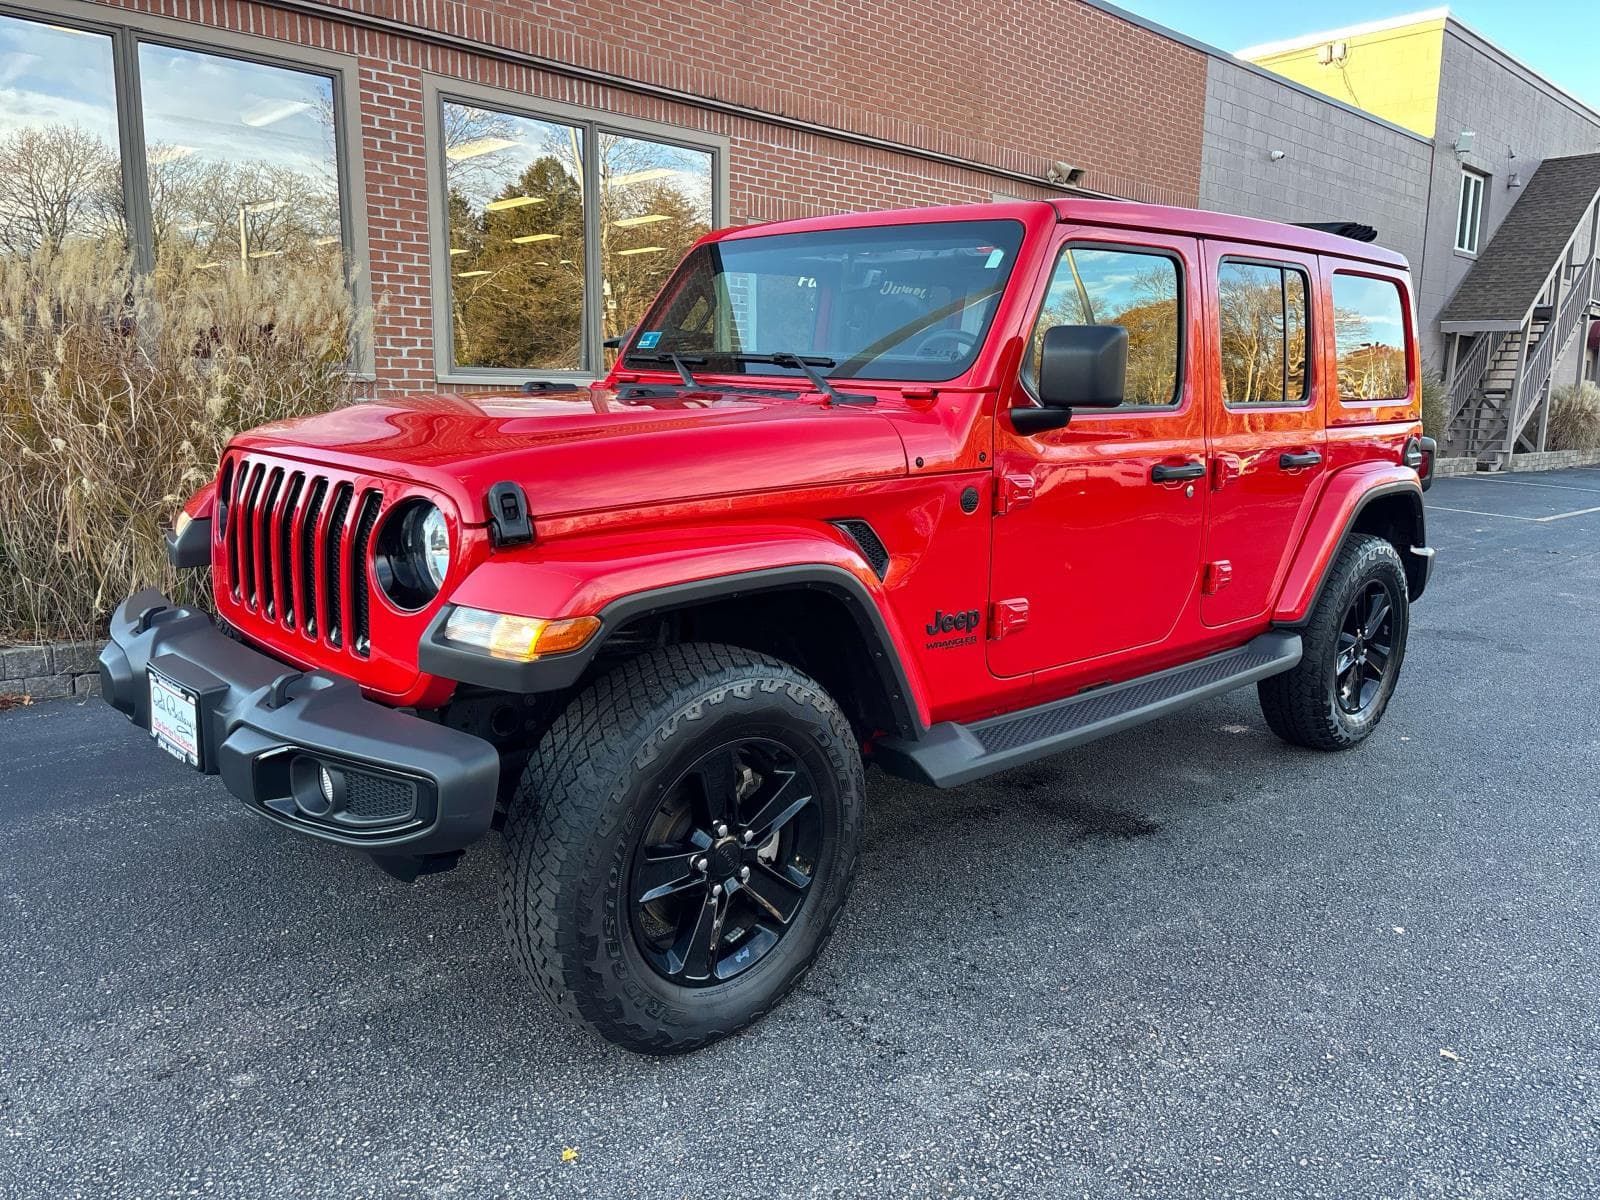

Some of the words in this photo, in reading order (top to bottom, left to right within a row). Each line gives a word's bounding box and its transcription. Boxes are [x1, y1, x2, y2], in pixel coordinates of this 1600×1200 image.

[926, 609, 980, 635] Jeep
[926, 635, 977, 649] WRANGLER
[602, 806, 688, 1026] BRIDGESTONE
